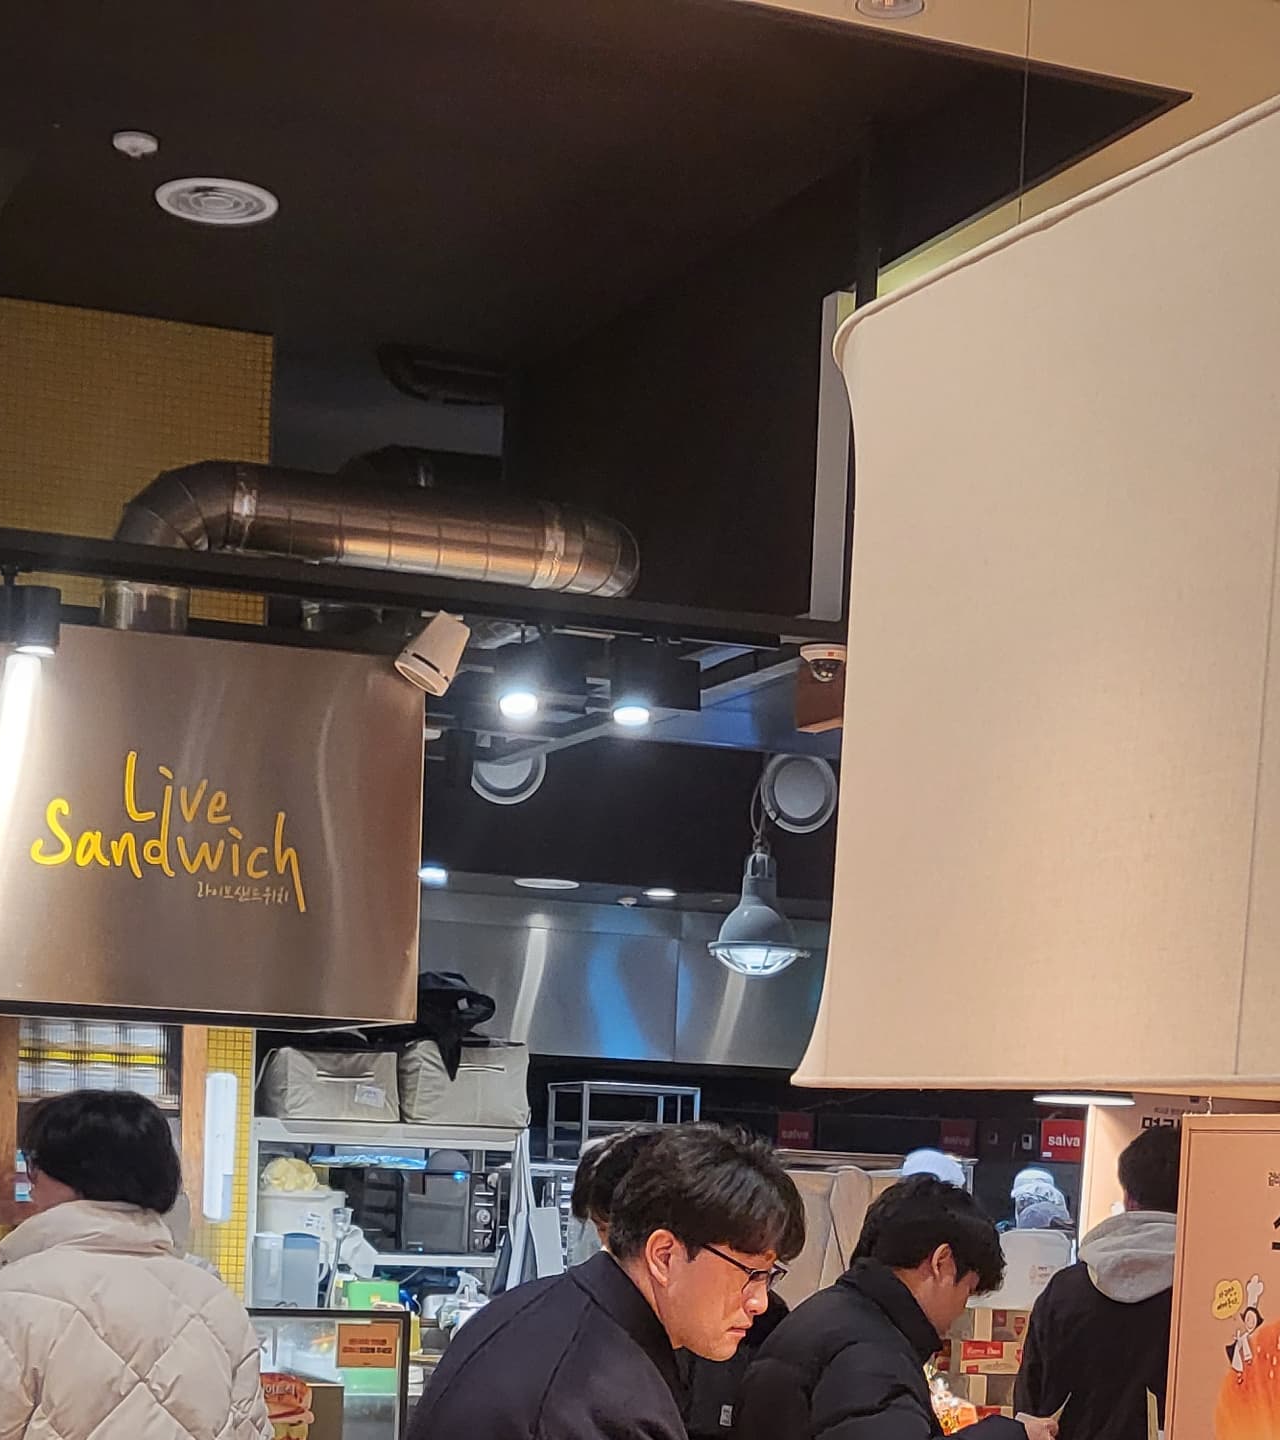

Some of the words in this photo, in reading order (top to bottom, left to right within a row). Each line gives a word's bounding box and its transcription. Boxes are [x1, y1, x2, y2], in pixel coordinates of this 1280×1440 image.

[125, 750, 231, 826] Live
[31, 798, 307, 913] Sandwich
[1048, 1133, 1080, 1147] salva
